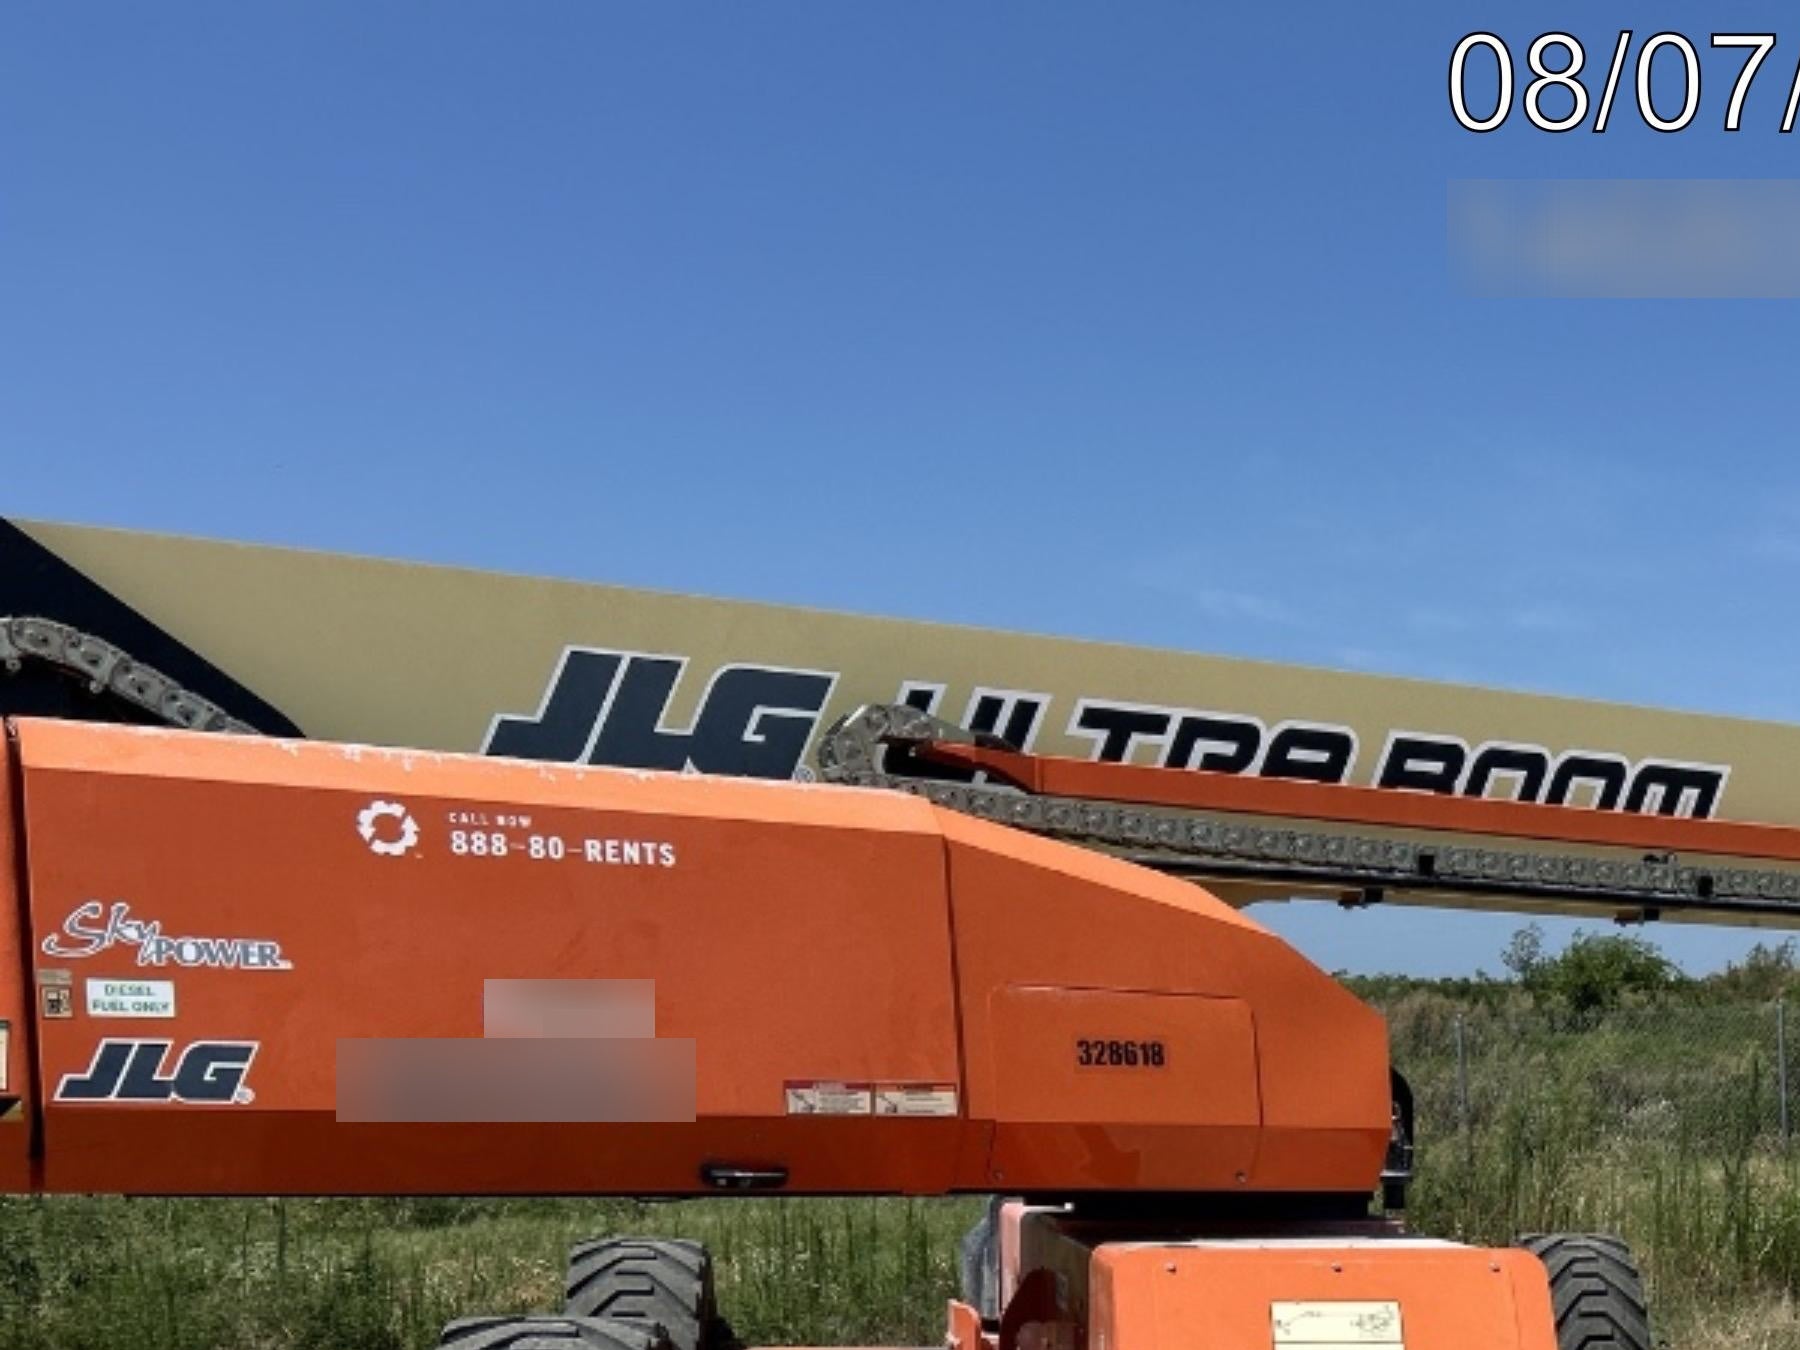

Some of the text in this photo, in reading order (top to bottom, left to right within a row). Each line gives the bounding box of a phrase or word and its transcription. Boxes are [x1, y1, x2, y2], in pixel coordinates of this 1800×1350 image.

[480, 645, 841, 781] JLG
[450, 829, 678, 868] 888-80-RENTS
[54, 1038, 261, 1105] JLG
[1076, 1039, 1165, 1067] 328618
